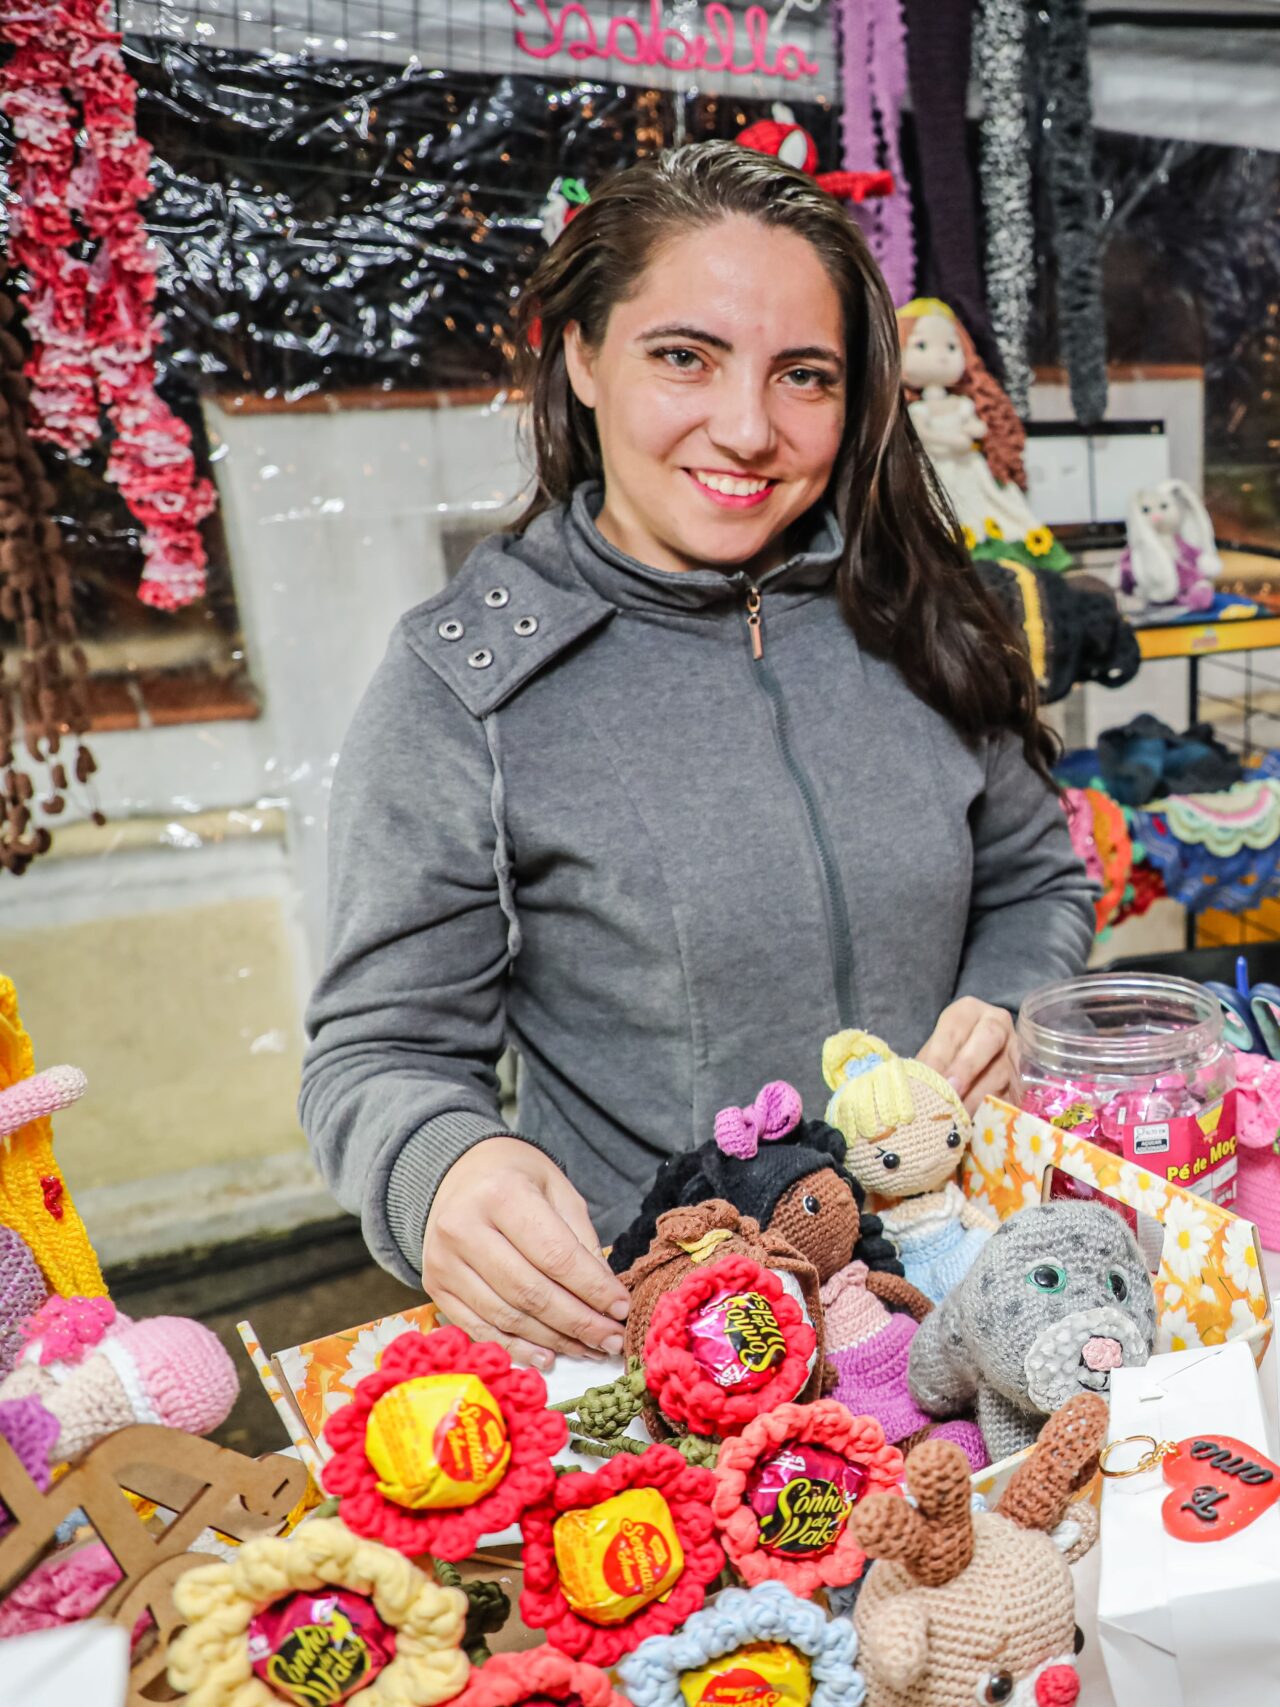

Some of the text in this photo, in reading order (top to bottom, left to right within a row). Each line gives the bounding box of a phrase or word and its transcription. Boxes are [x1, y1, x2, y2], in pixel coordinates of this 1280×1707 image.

[1167, 1161, 1190, 1182] Pé
[1193, 1157, 1208, 1175] de
[1210, 1136, 1238, 1165] Moç
[724, 1308, 786, 1372] Sonho
[748, 1292, 786, 1345] Valsa
[751, 1314, 766, 1327] de
[759, 1477, 845, 1544] Sonho
[772, 1517, 840, 1549] Valsa
[811, 1513, 826, 1528] de
[621, 1517, 655, 1593] Serenata
[267, 1625, 329, 1706] Sonho
